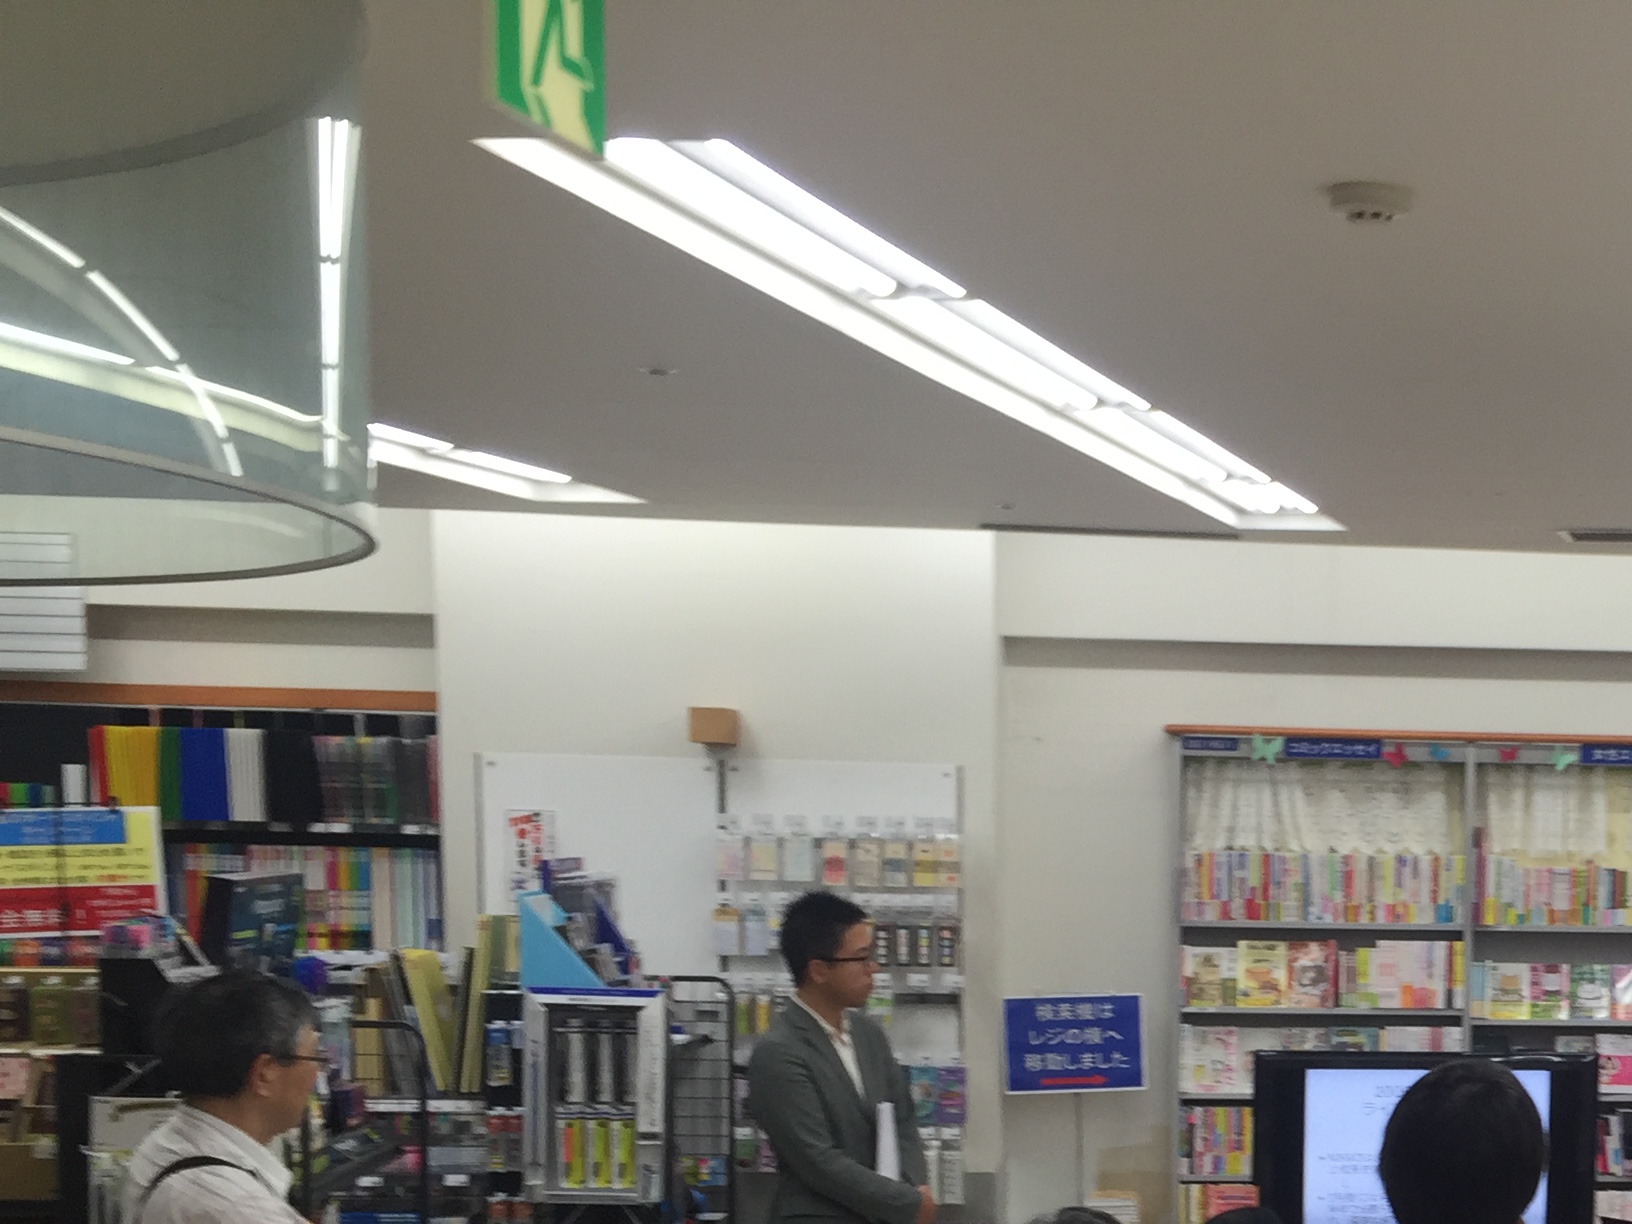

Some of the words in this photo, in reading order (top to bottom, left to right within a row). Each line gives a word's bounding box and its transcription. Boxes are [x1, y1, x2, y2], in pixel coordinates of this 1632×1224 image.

[1023, 1051, 1131, 1072] 移動しました
